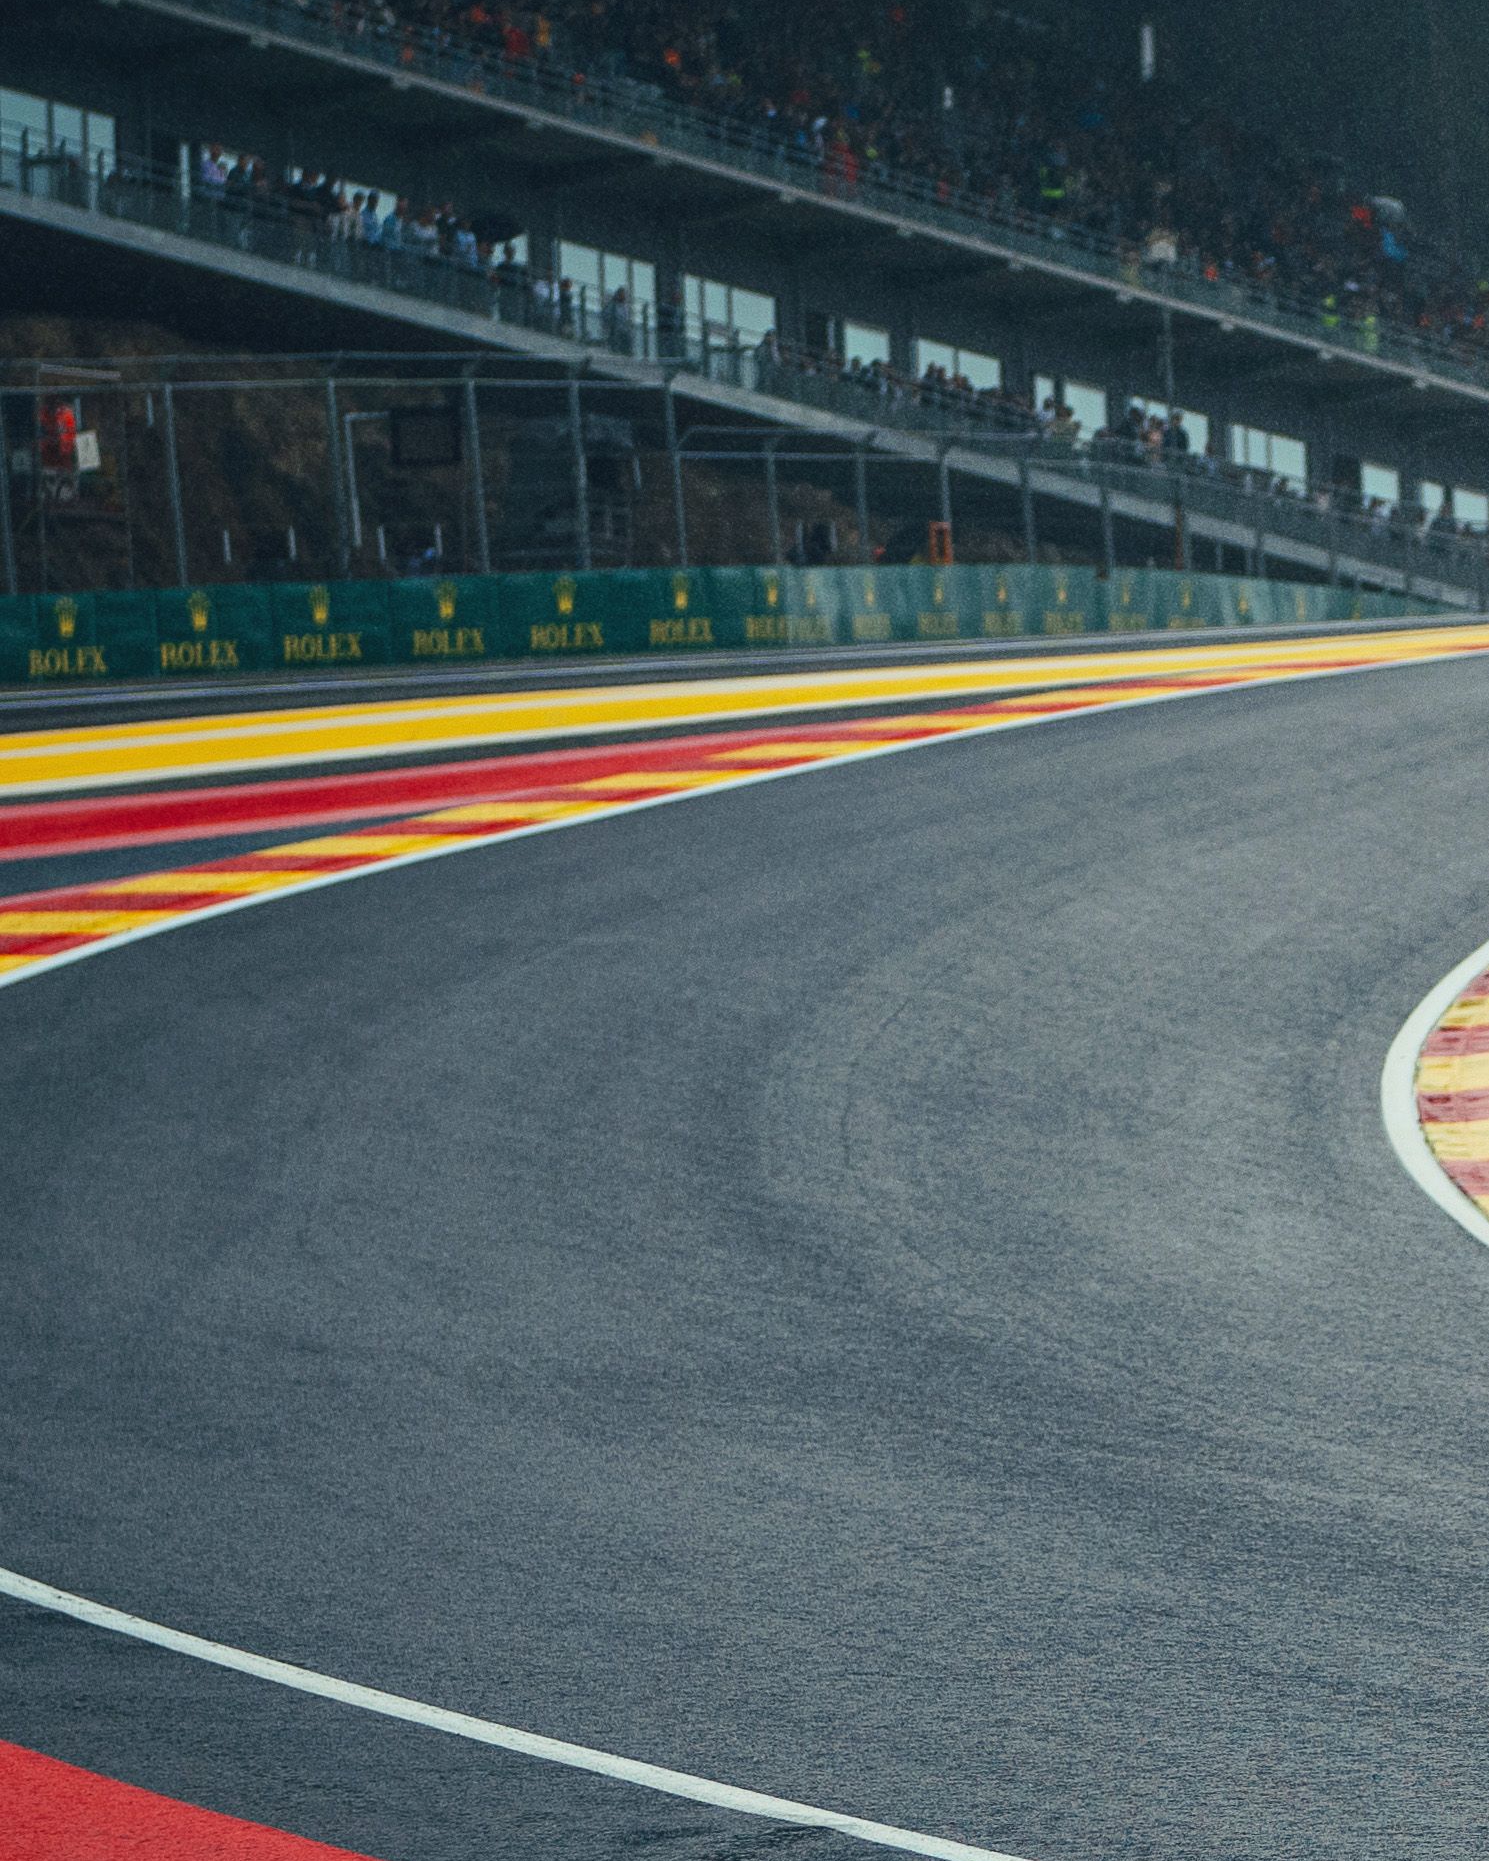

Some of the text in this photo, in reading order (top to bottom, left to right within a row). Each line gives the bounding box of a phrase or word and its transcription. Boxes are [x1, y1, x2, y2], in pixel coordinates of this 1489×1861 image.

[413, 628, 484, 656] ROLEX
[530, 623, 603, 649] ROLEX
[650, 618, 713, 643] ROLEX
[29, 646, 107, 675] ROLEX
[160, 641, 238, 667] ROLEX
[285, 633, 361, 661] ROLEX
